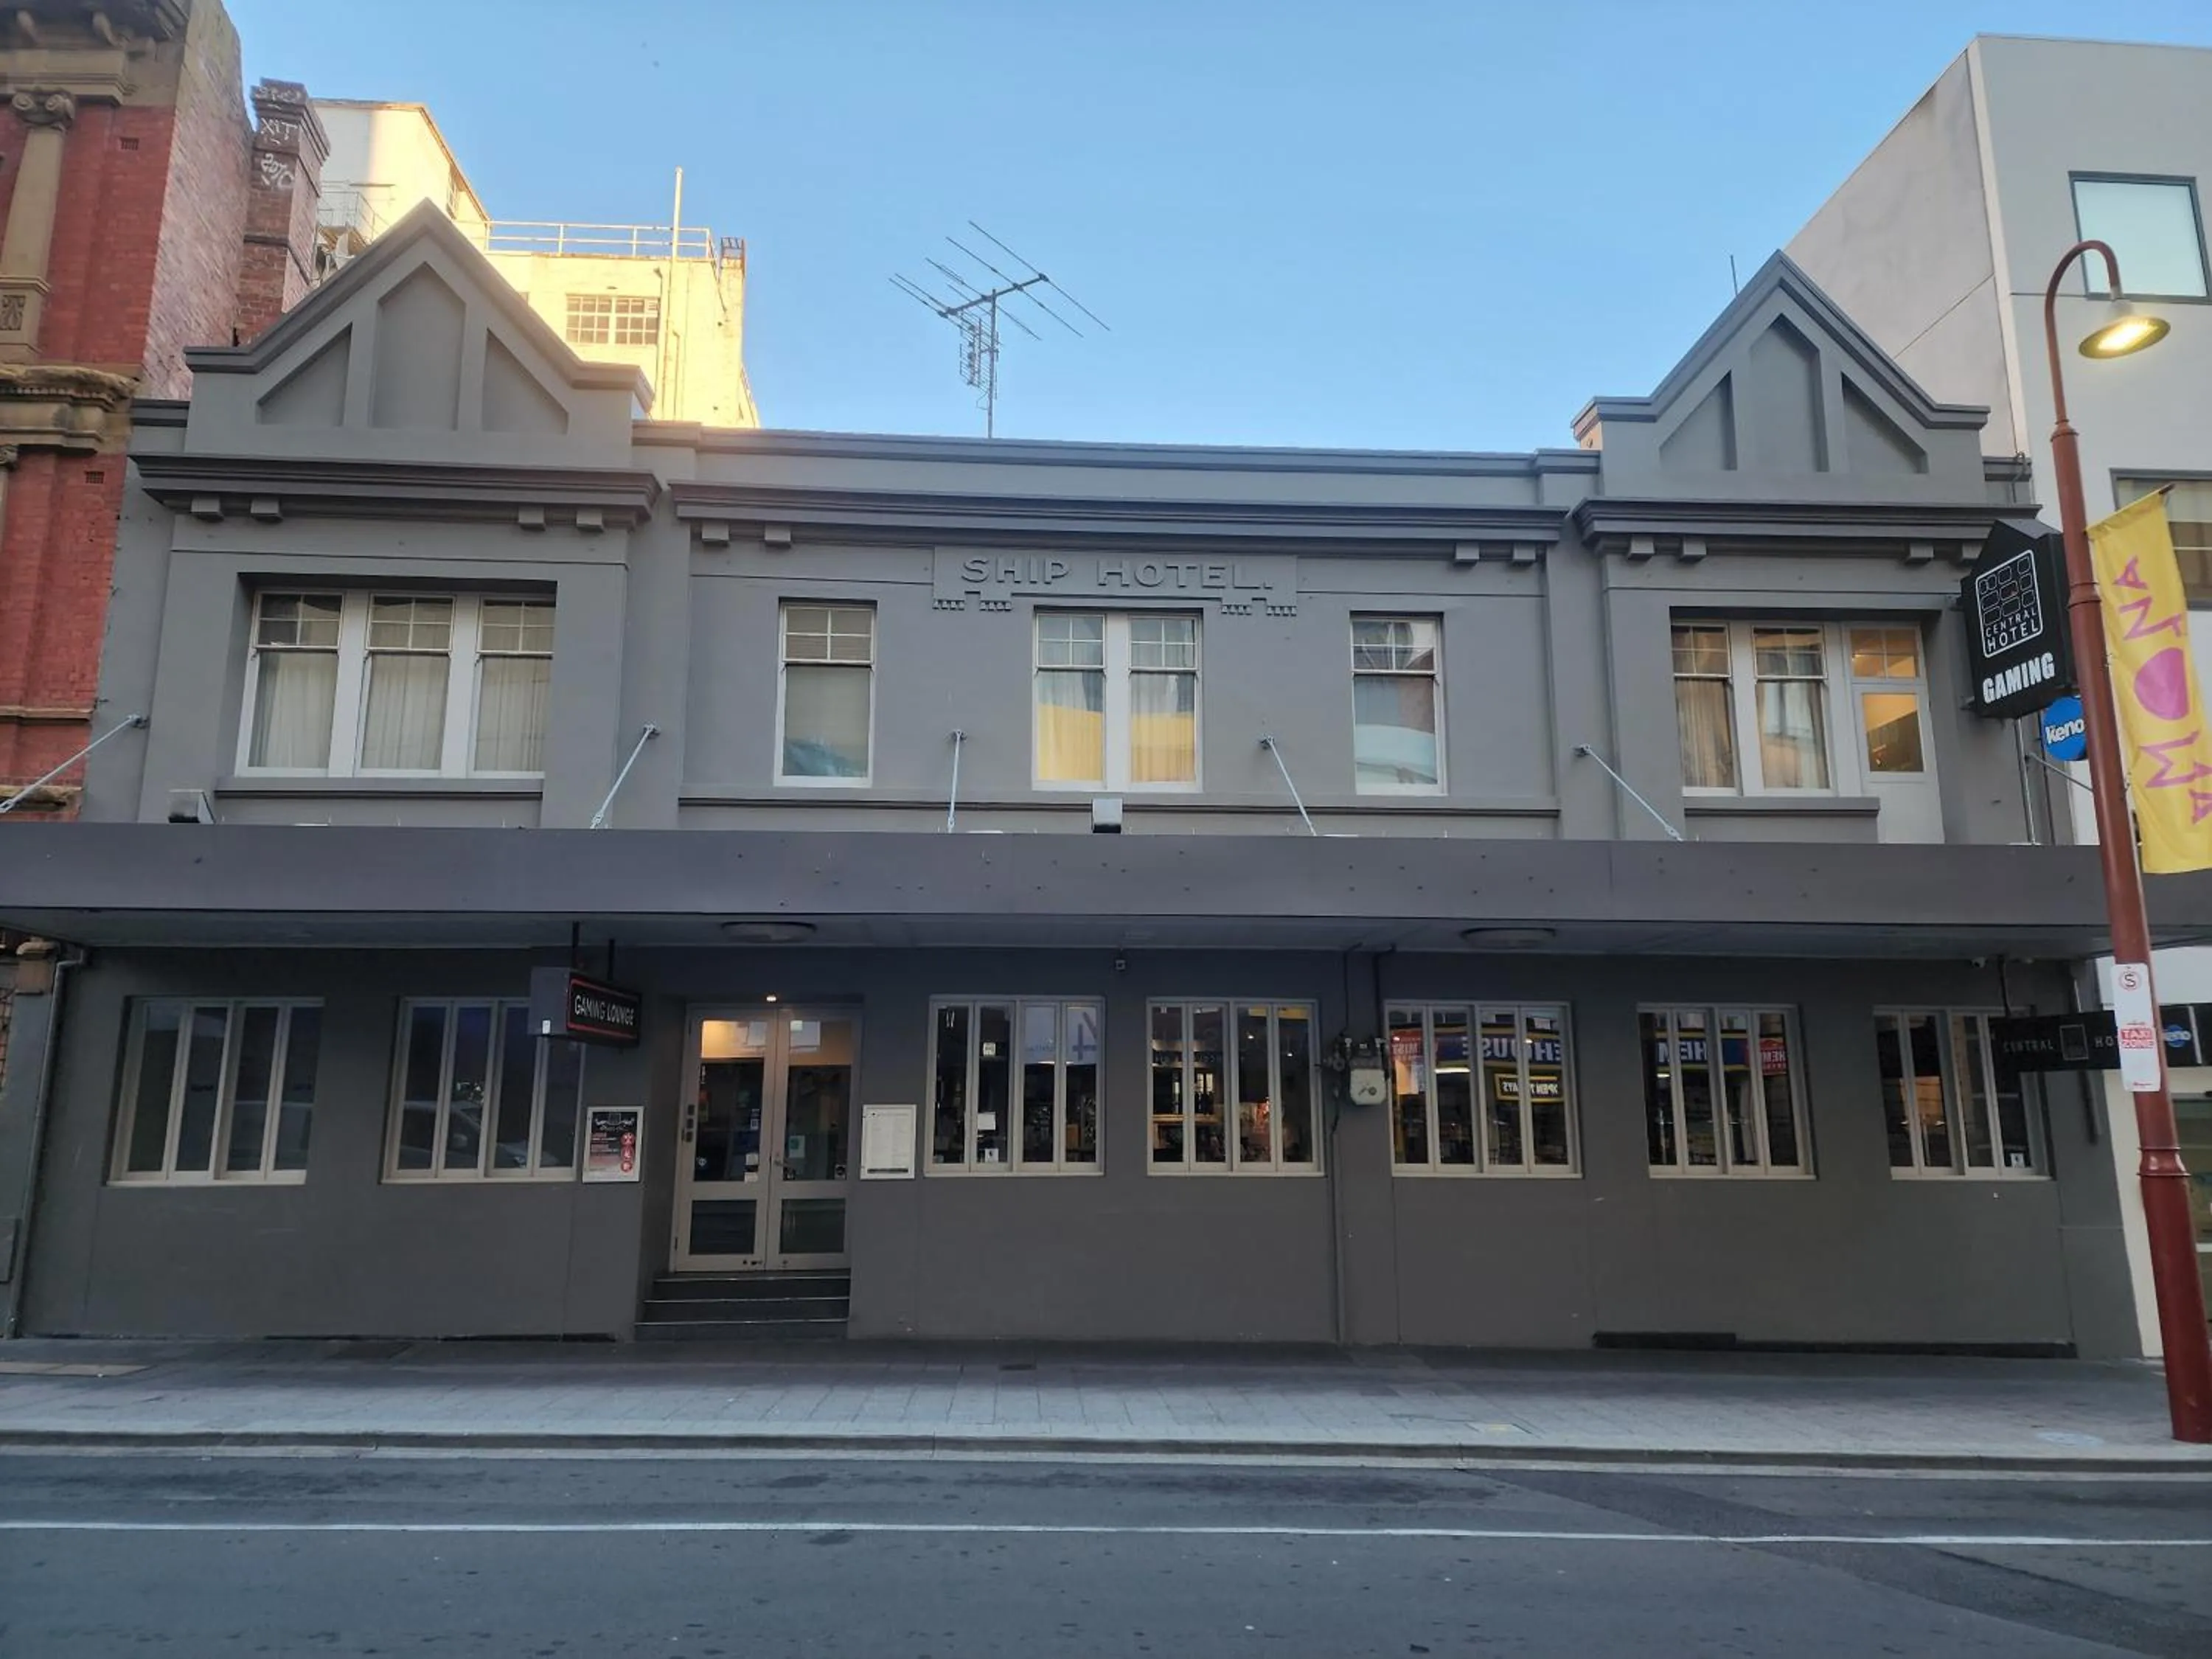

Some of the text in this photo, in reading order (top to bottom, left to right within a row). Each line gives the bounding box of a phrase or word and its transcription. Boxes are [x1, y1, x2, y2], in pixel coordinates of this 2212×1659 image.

[961, 557, 1070, 584] SHIP
[1986, 606, 2037, 638] CENTRAL
[1986, 618, 2039, 653] HOTEL
[1983, 652, 2056, 703] GAMING
[2045, 718, 2084, 744] Keno
[2124, 973, 2136, 987] S
[574, 994, 634, 1026] GAMING LOUNGE
[2094, 1035, 2119, 1048] HO
[2121, 1028, 2152, 1040] TAXI
